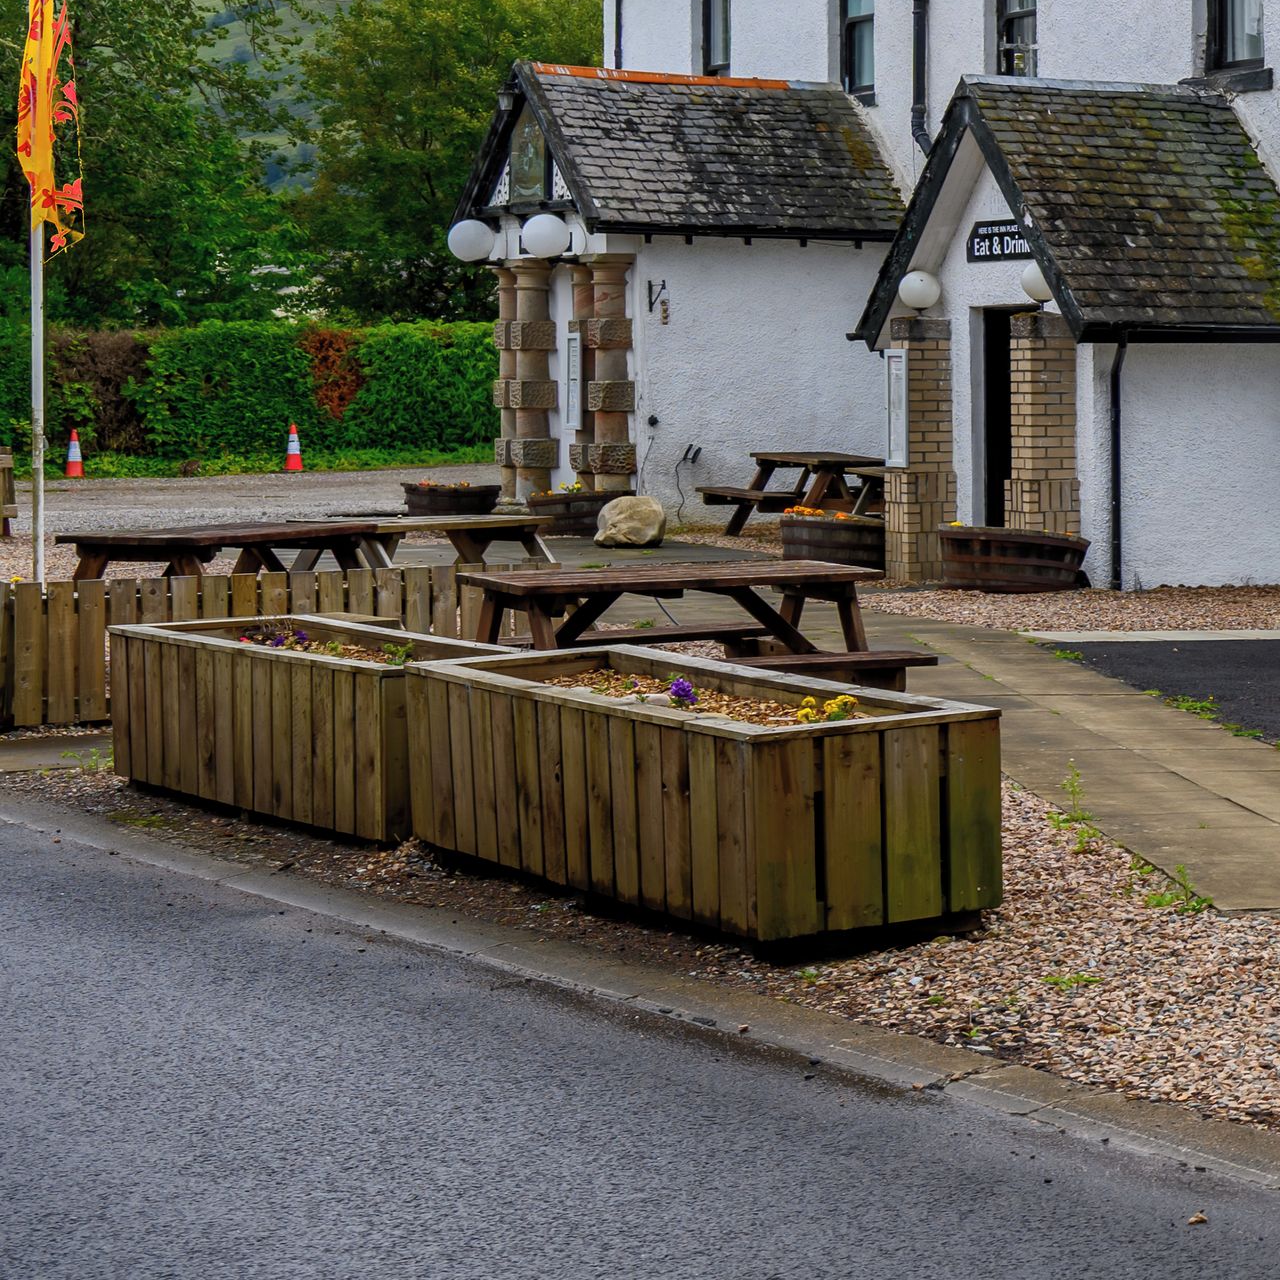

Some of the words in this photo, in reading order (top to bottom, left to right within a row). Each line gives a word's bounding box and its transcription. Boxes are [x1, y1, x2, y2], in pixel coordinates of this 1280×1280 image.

[1007, 224, 1018, 232] PLACE
[974, 238, 990, 256] Eat
[992, 236, 1001, 255] &
